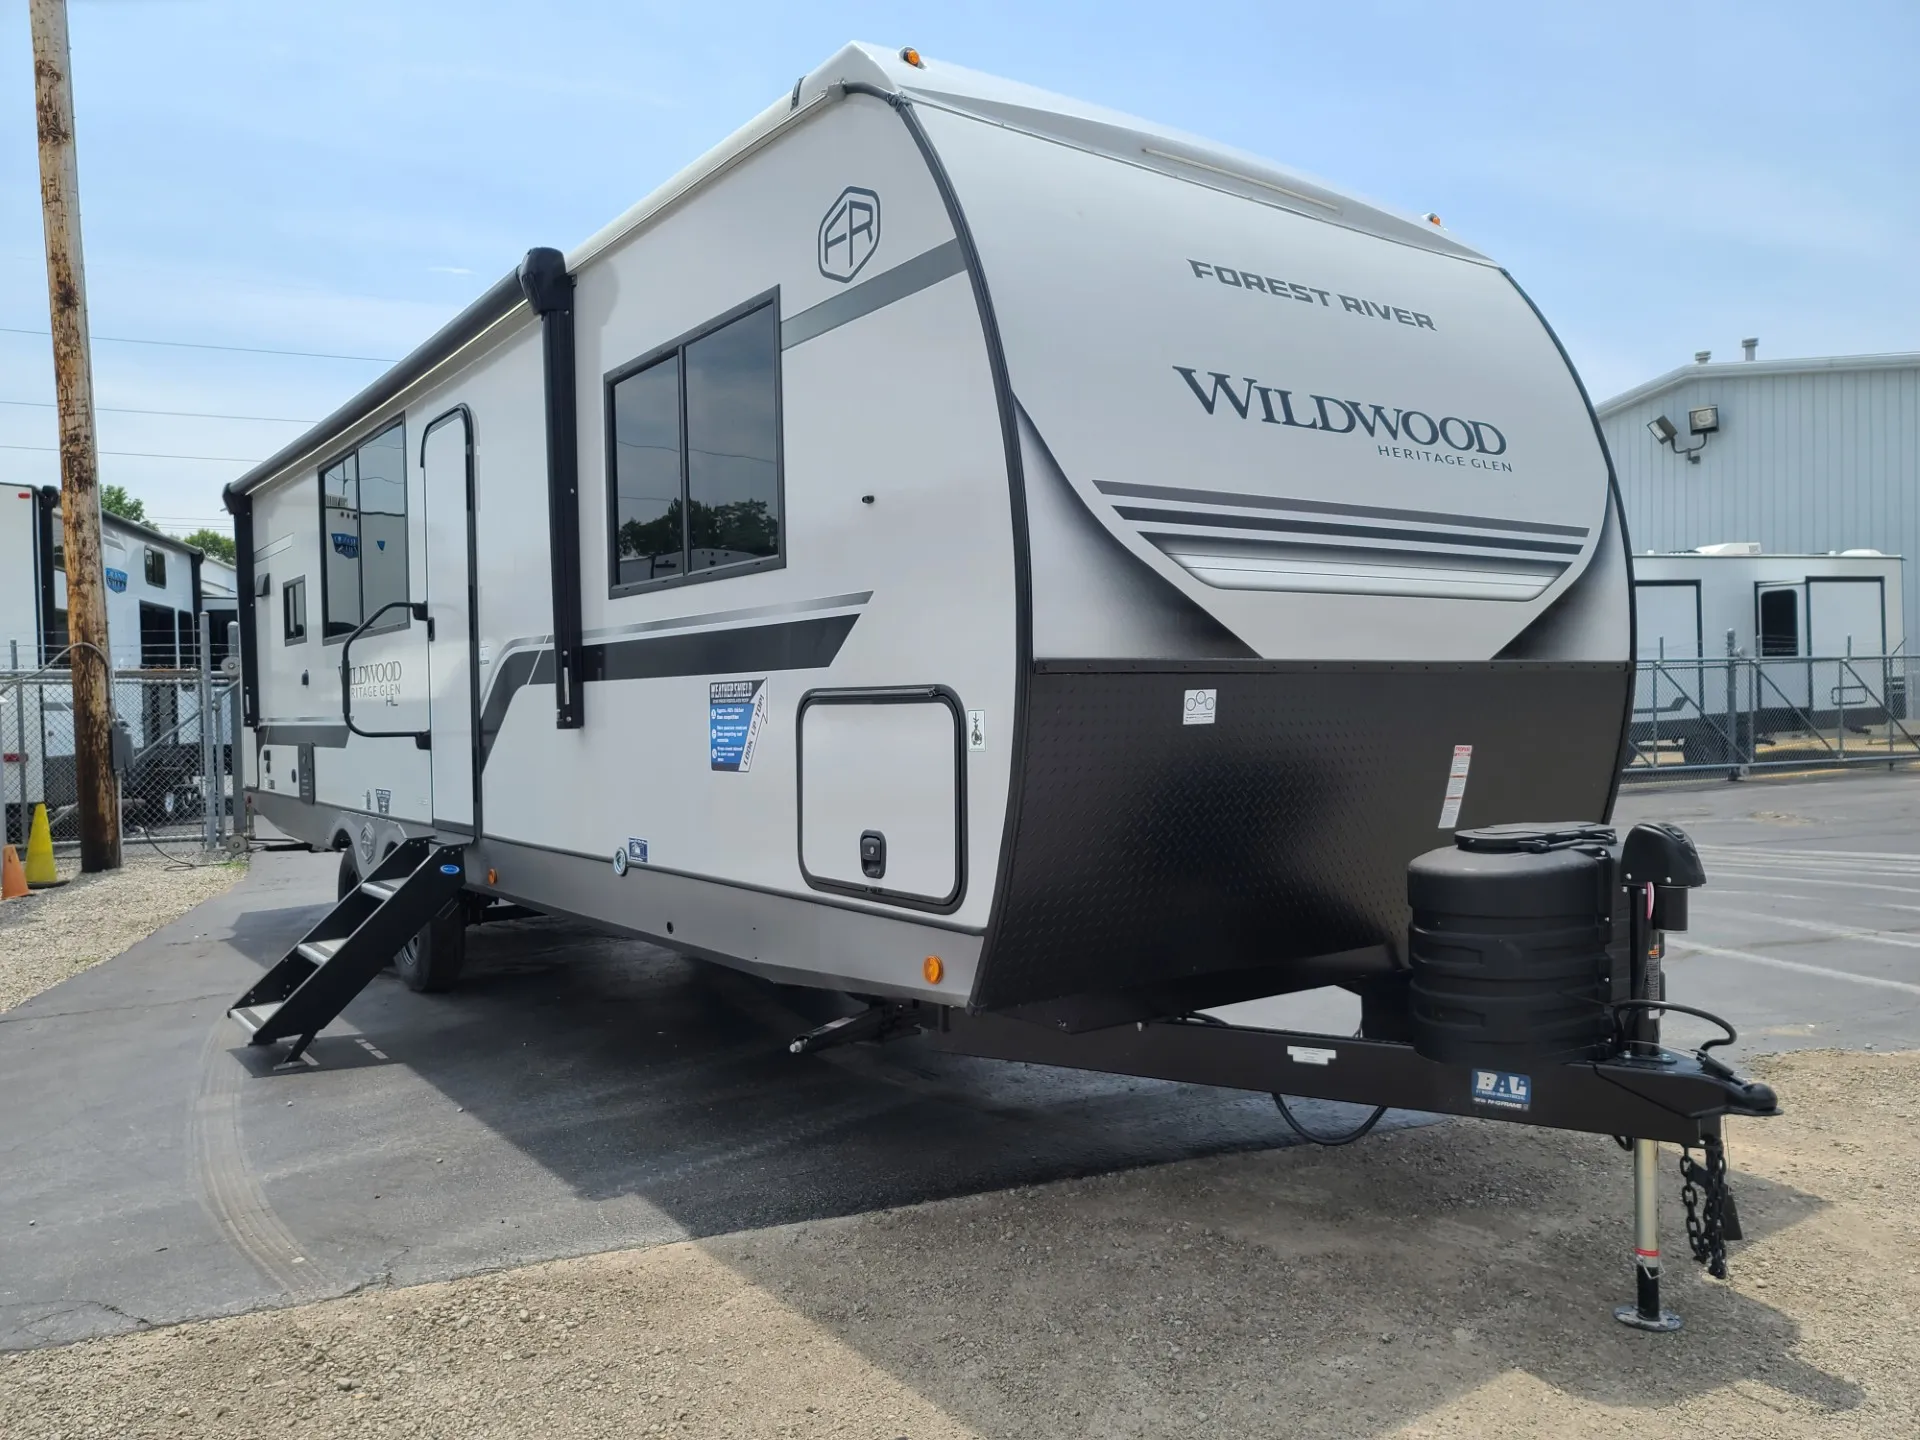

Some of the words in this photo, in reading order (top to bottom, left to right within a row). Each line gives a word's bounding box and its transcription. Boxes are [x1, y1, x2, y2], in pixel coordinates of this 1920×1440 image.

[1186, 258, 1331, 307] FOREST
[1336, 293, 1438, 331] RIVER
[1171, 365, 1508, 456] WILDWOOD
[1377, 444, 1466, 467] HERITAGE
[1470, 456, 1514, 473] GLEN
[338, 660, 402, 692] ILDWOOD
[350, 686, 377, 699] RITAGE
[379, 684, 401, 697] GLEN
